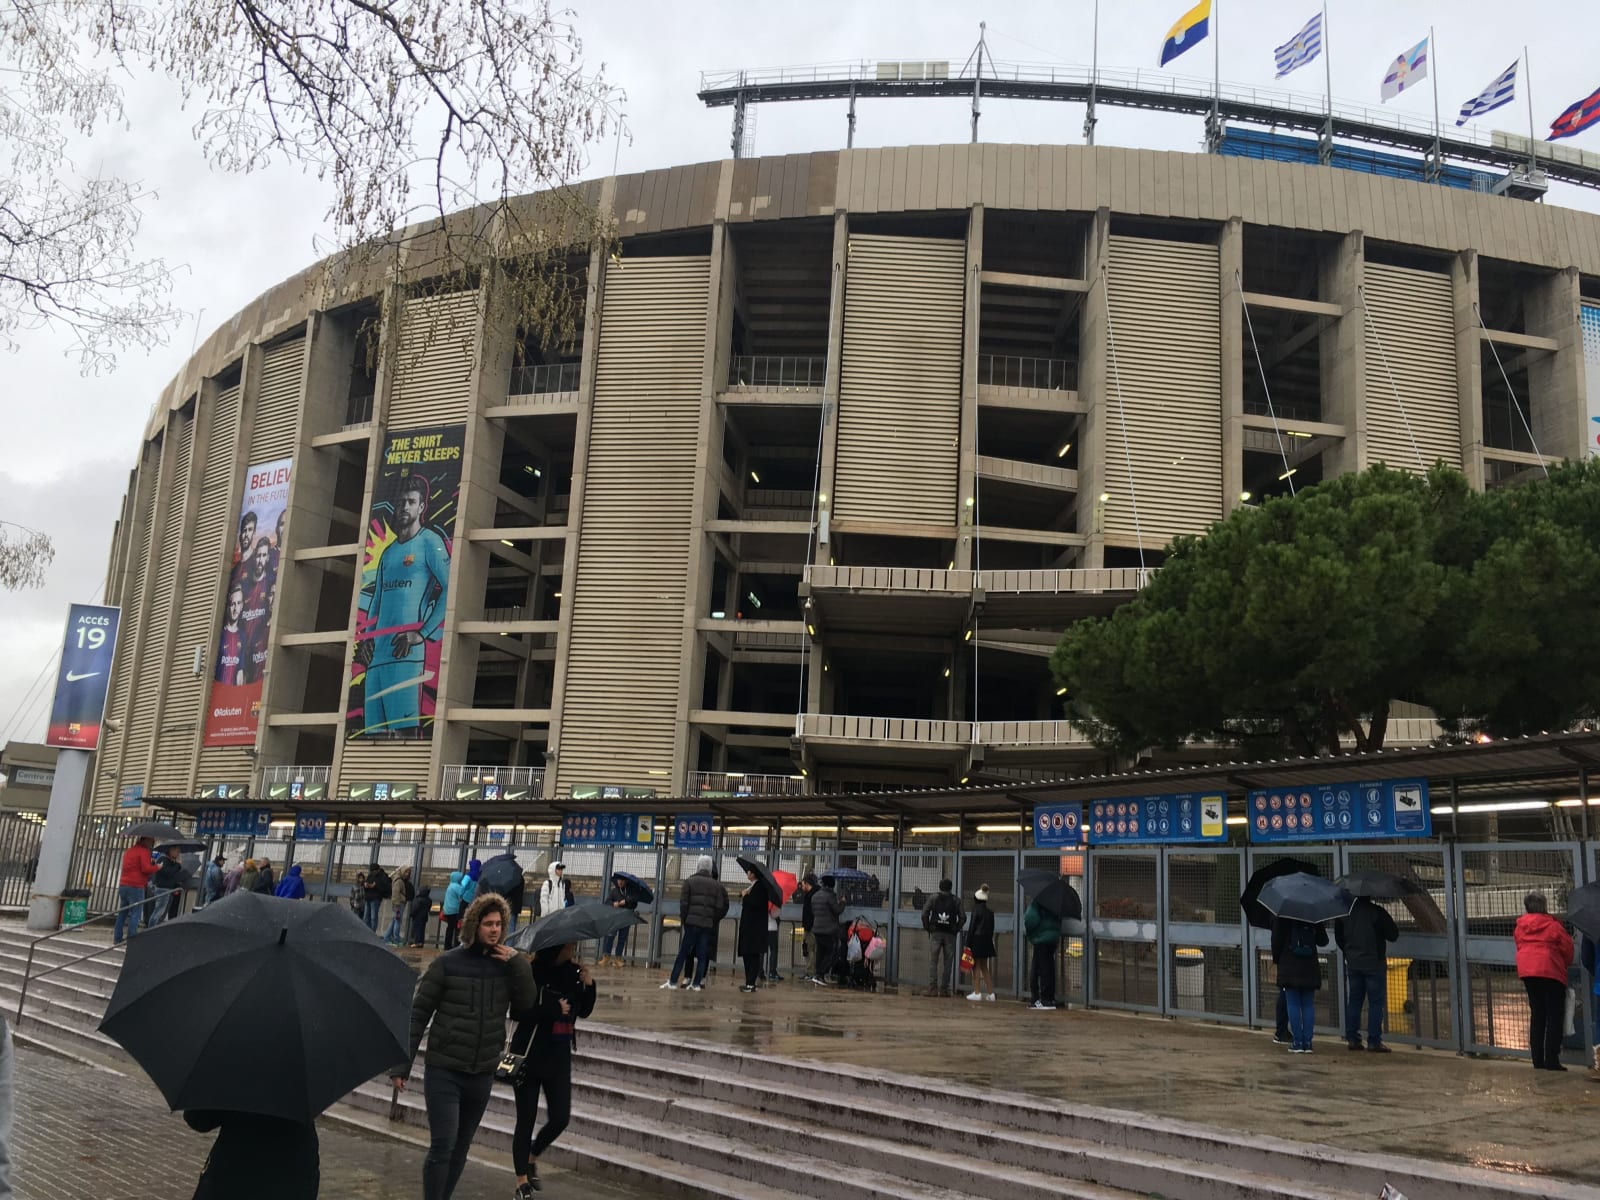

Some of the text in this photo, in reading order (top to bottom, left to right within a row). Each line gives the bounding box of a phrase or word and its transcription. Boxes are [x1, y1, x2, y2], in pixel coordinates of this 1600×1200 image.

[391, 434, 443, 451] THE SHIRT
[386, 446, 460, 464] NEVER SLEEPS
[248, 496, 256, 506] IN
[256, 493, 268, 503] THE
[78, 616, 110, 626] ACCÉS
[76, 626, 106, 650] 19
[374, 790, 388, 800] 55
[485, 792, 497, 800] 56
